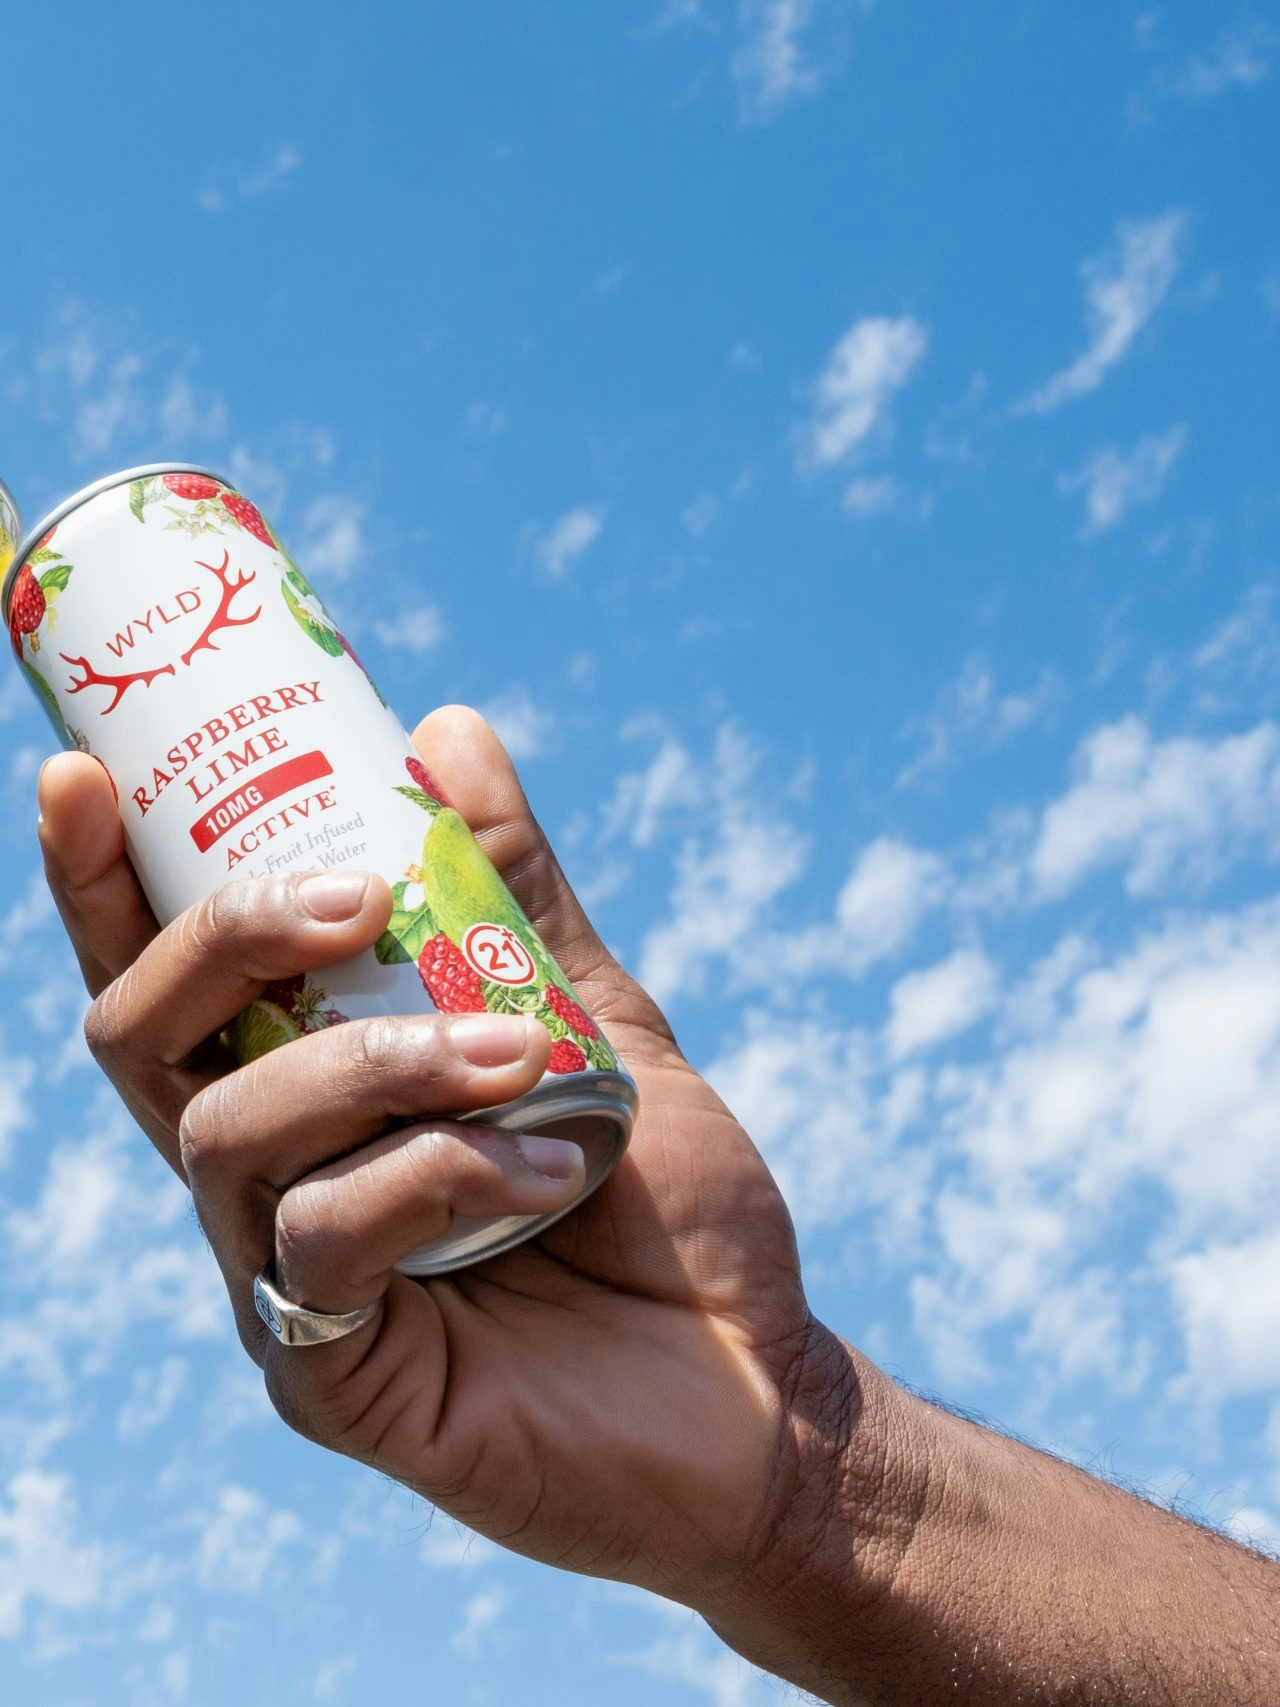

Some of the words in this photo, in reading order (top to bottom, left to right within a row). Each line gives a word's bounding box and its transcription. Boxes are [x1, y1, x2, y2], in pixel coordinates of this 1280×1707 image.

[131, 680, 325, 817] RASPBERRY
[185, 726, 289, 804] LIME
[205, 785, 264, 835] 10MG
[305, 812, 365, 850] Infused
[317, 841, 368, 870] Water
